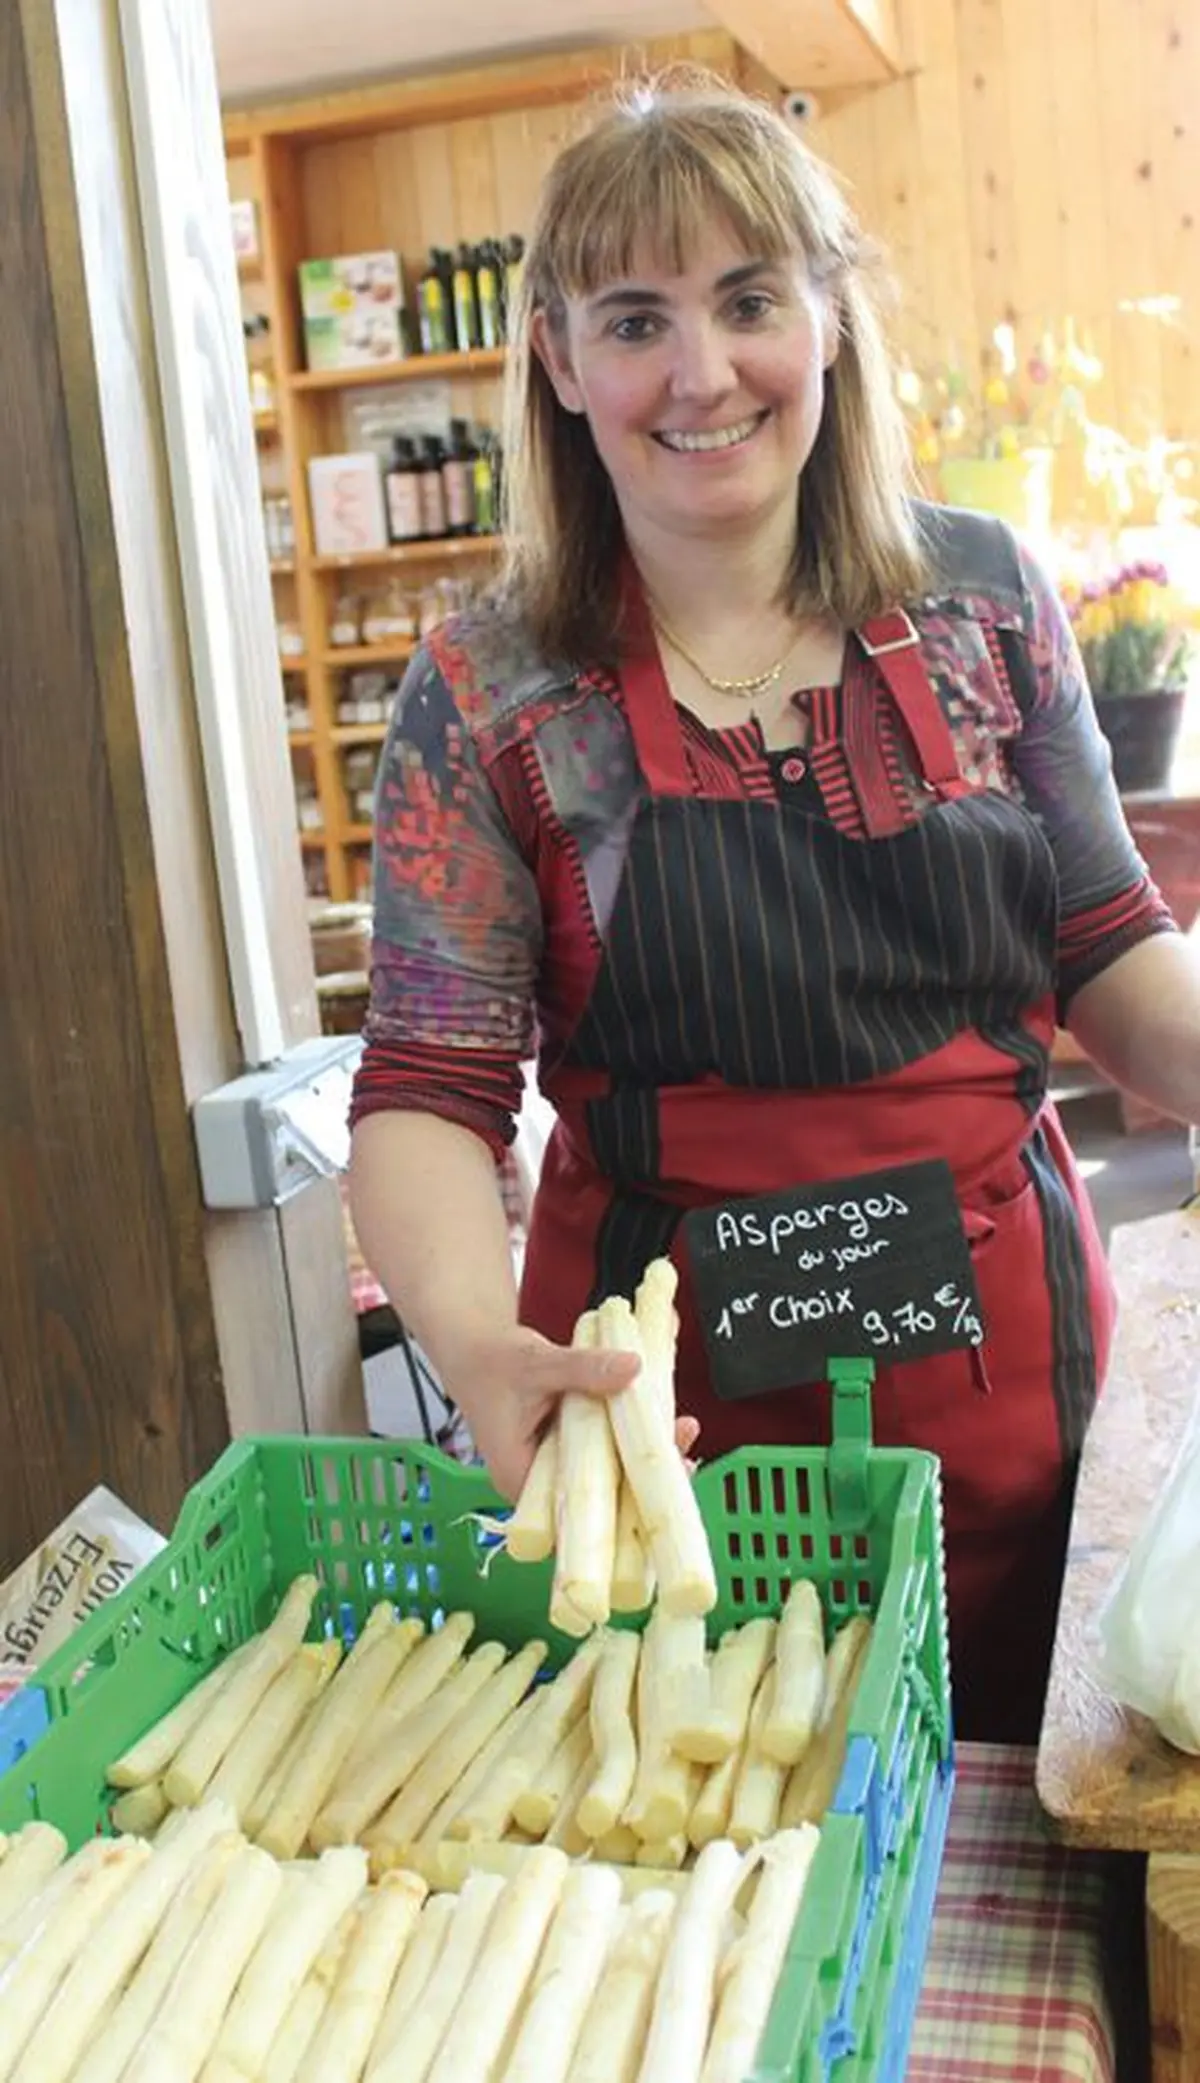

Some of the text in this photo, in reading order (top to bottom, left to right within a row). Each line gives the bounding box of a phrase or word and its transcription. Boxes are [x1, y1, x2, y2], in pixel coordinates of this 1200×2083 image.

[798, 1240, 890, 1271] du jour
[715, 1288, 855, 1339] 1er Choix
